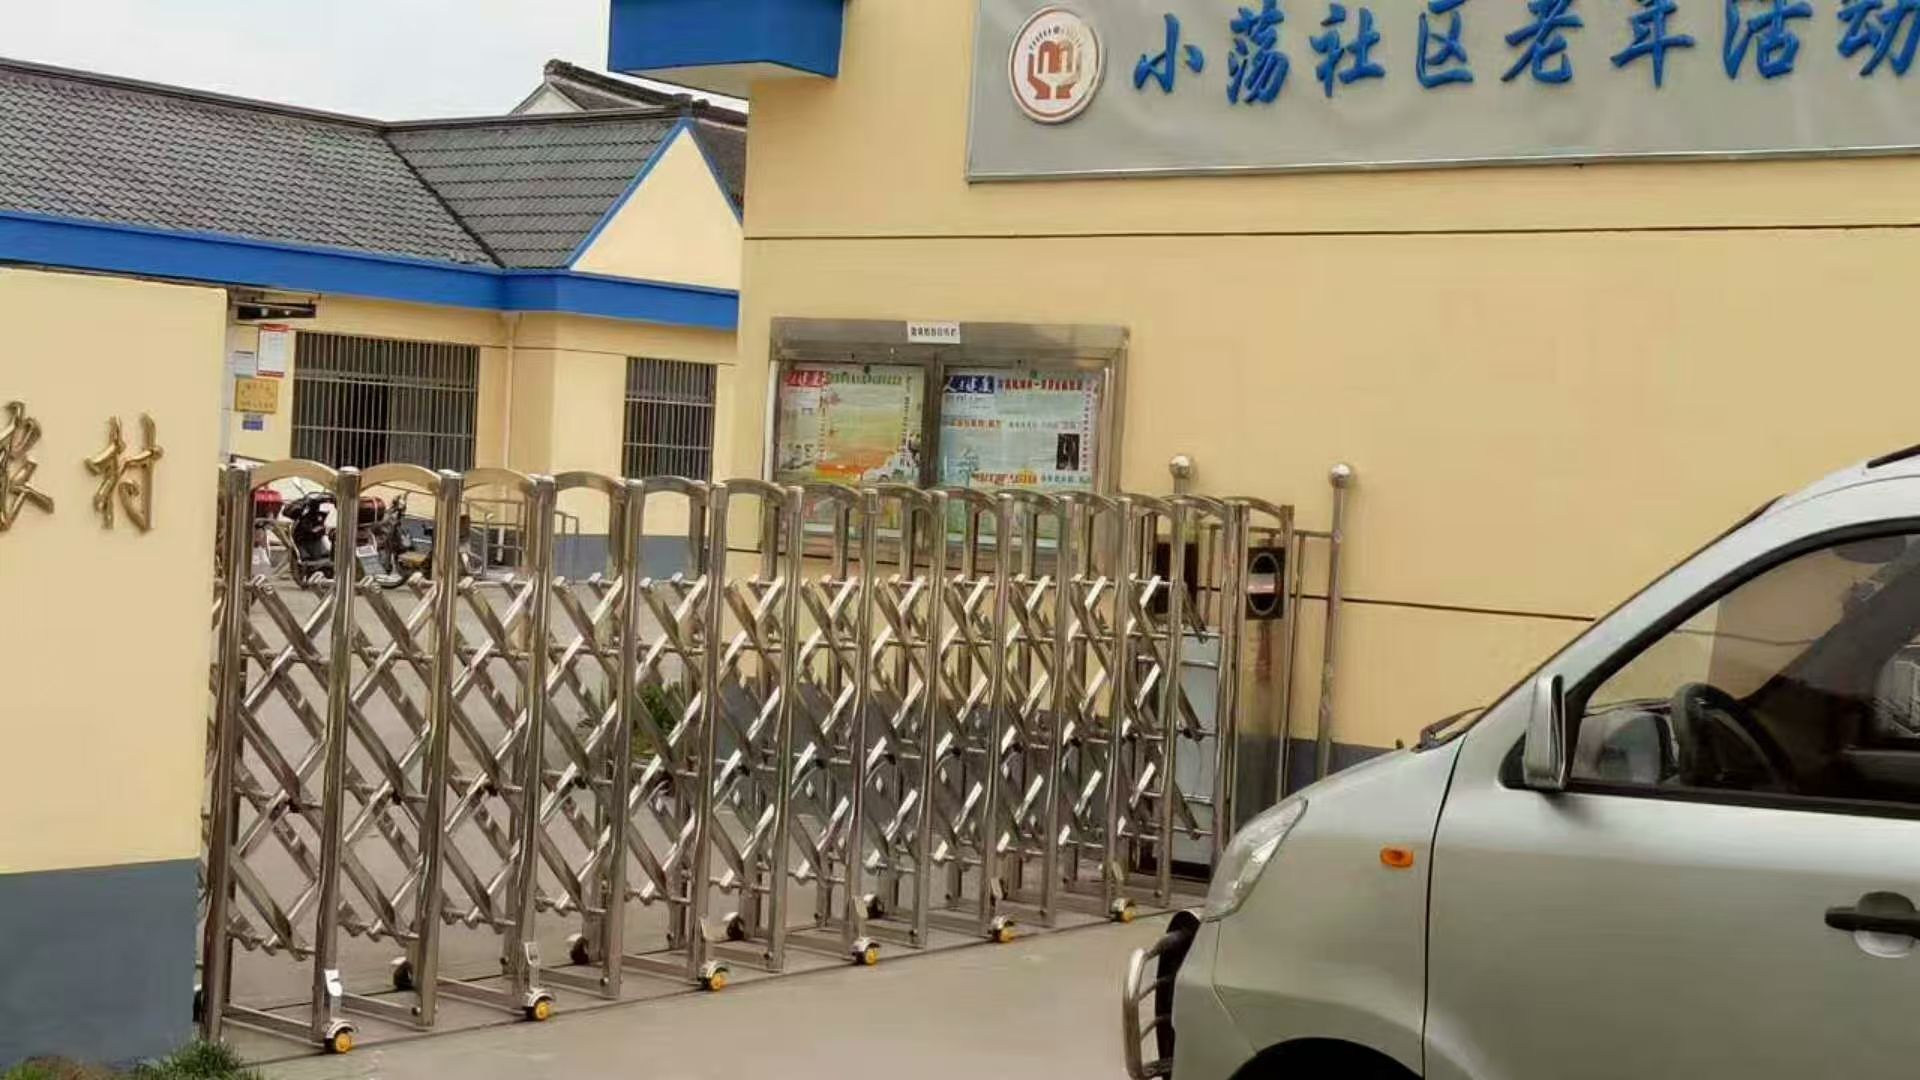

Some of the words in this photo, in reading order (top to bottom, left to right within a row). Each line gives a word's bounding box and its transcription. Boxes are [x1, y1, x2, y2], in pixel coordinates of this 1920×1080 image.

[1135, 0, 1920, 104] 小荡社区老年活动
